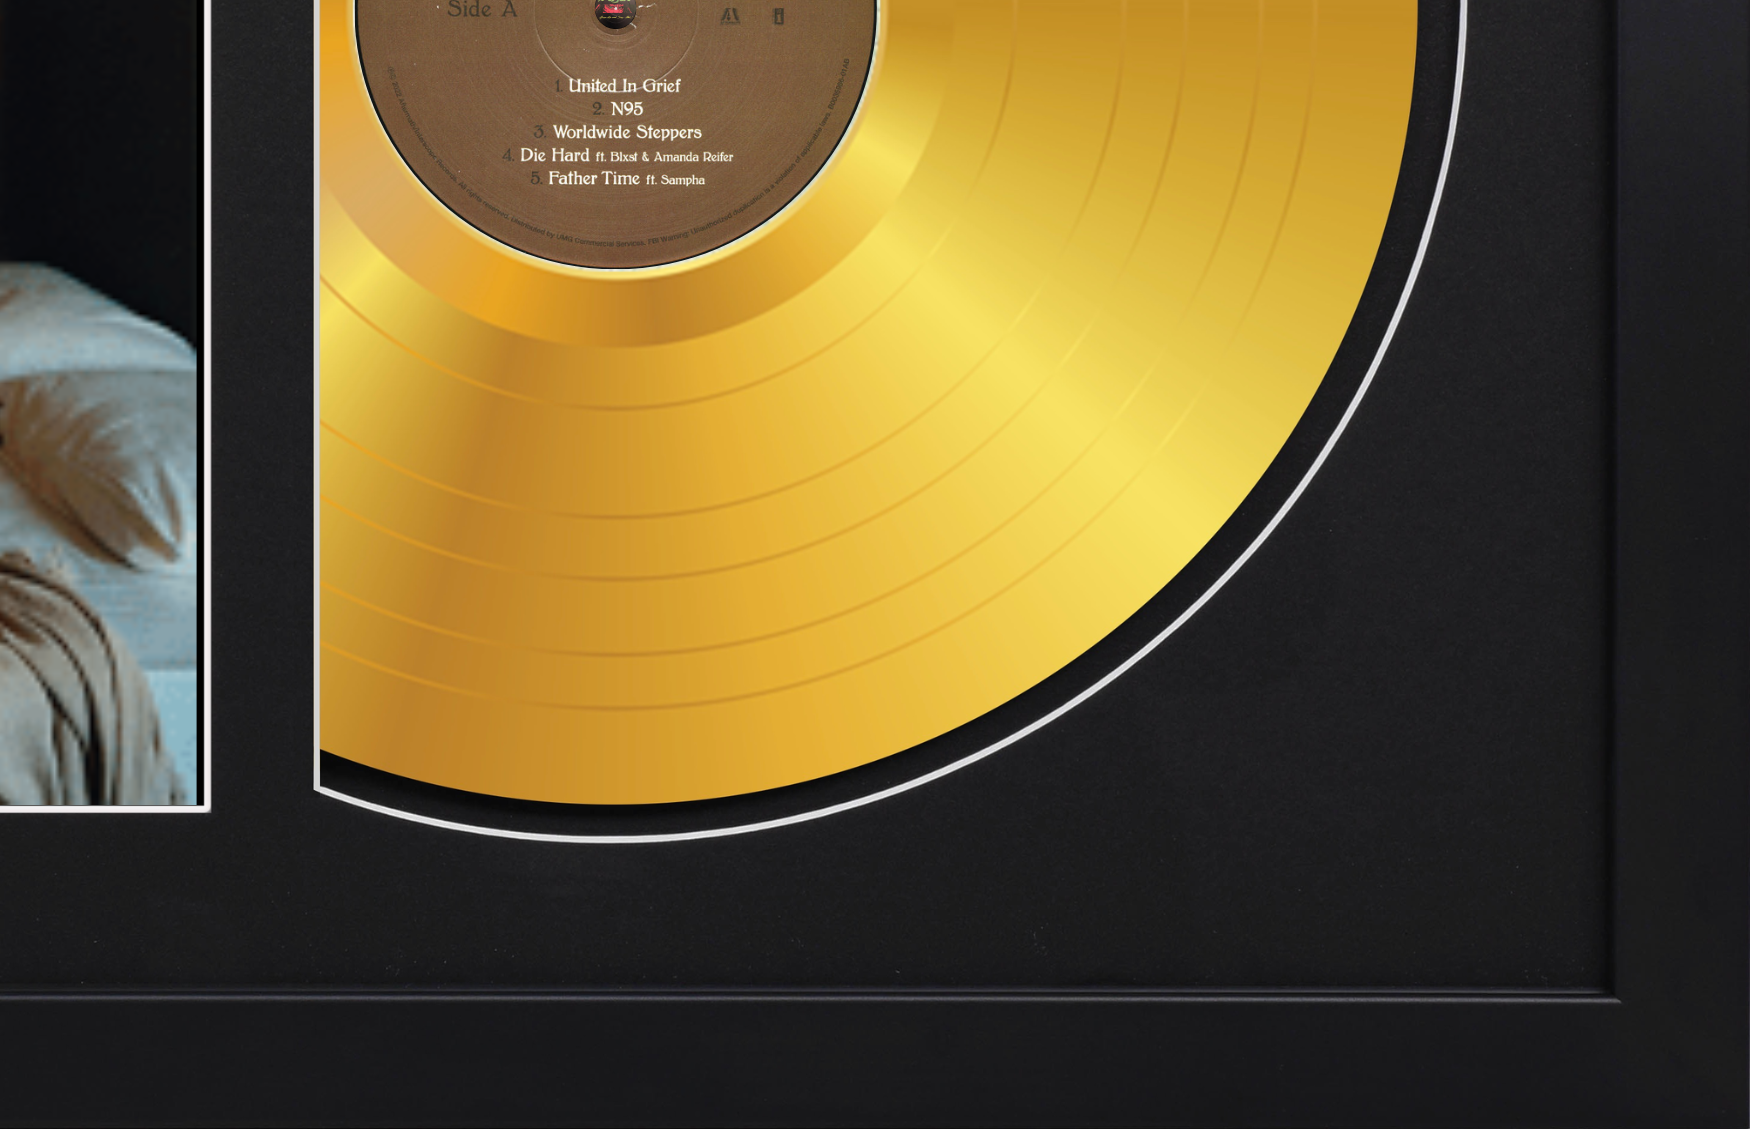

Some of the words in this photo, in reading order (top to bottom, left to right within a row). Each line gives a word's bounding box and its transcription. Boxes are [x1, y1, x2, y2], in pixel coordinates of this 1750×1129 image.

[447, 0, 492, 17] Side
[501, 0, 518, 17] A
[554, 79, 563, 92] 1.
[568, 78, 618, 93] United
[622, 79, 638, 92] In
[641, 79, 681, 92] Grief
[592, 101, 605, 116] 2.
[611, 102, 643, 115] N95
[534, 124, 547, 139] 3.
[553, 125, 630, 139] Worldwide
[637, 125, 702, 141] Steppers
[502, 148, 515, 162] 4.
[521, 148, 546, 161] Die
[552, 148, 589, 162] Hard
[595, 151, 607, 162] ft.
[611, 152, 637, 161] Blxst
[642, 152, 649, 161] &
[654, 152, 699, 161] Amanda
[704, 152, 733, 161] Reifer
[530, 171, 543, 185] 5.
[549, 171, 597, 185] Father
[601, 171, 640, 185] Time
[646, 174, 658, 185] ft.
[661, 175, 705, 186] Sampha
